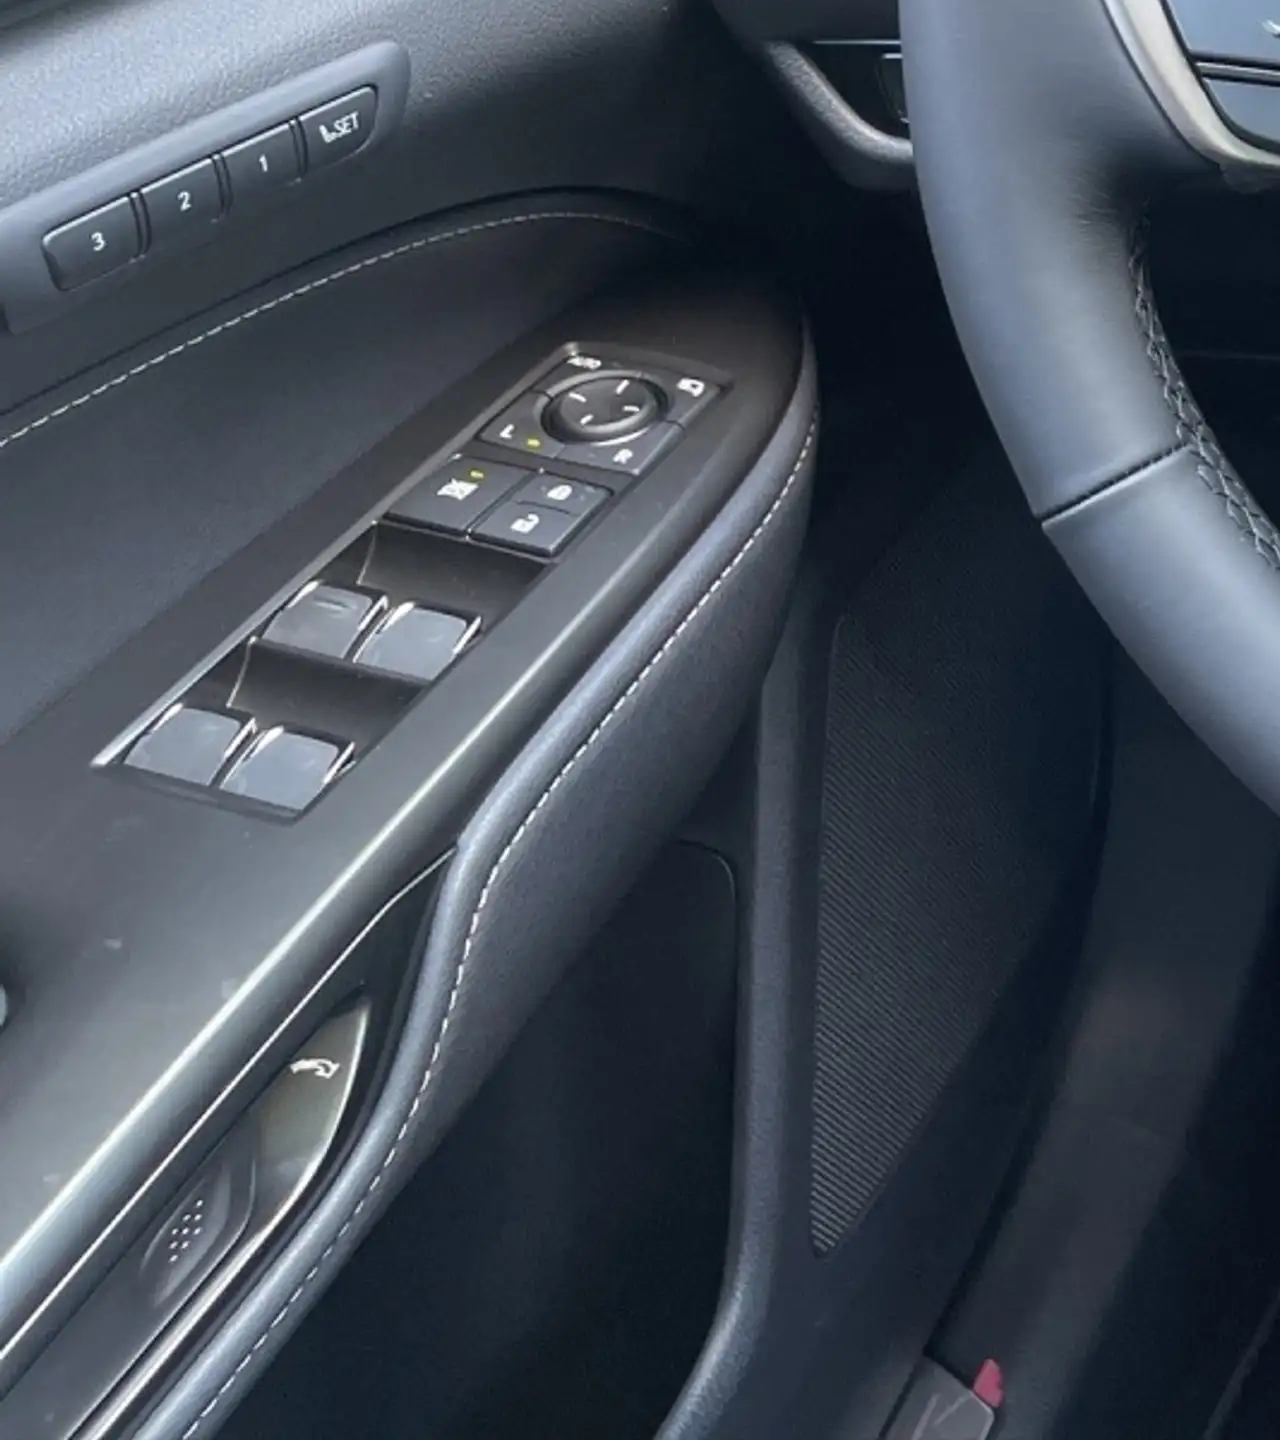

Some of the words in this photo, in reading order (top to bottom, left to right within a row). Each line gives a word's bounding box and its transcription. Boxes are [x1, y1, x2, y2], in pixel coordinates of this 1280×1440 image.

[259, 154, 269, 173] 1
[176, 191, 192, 212] 2
[90, 231, 107, 252] 3
